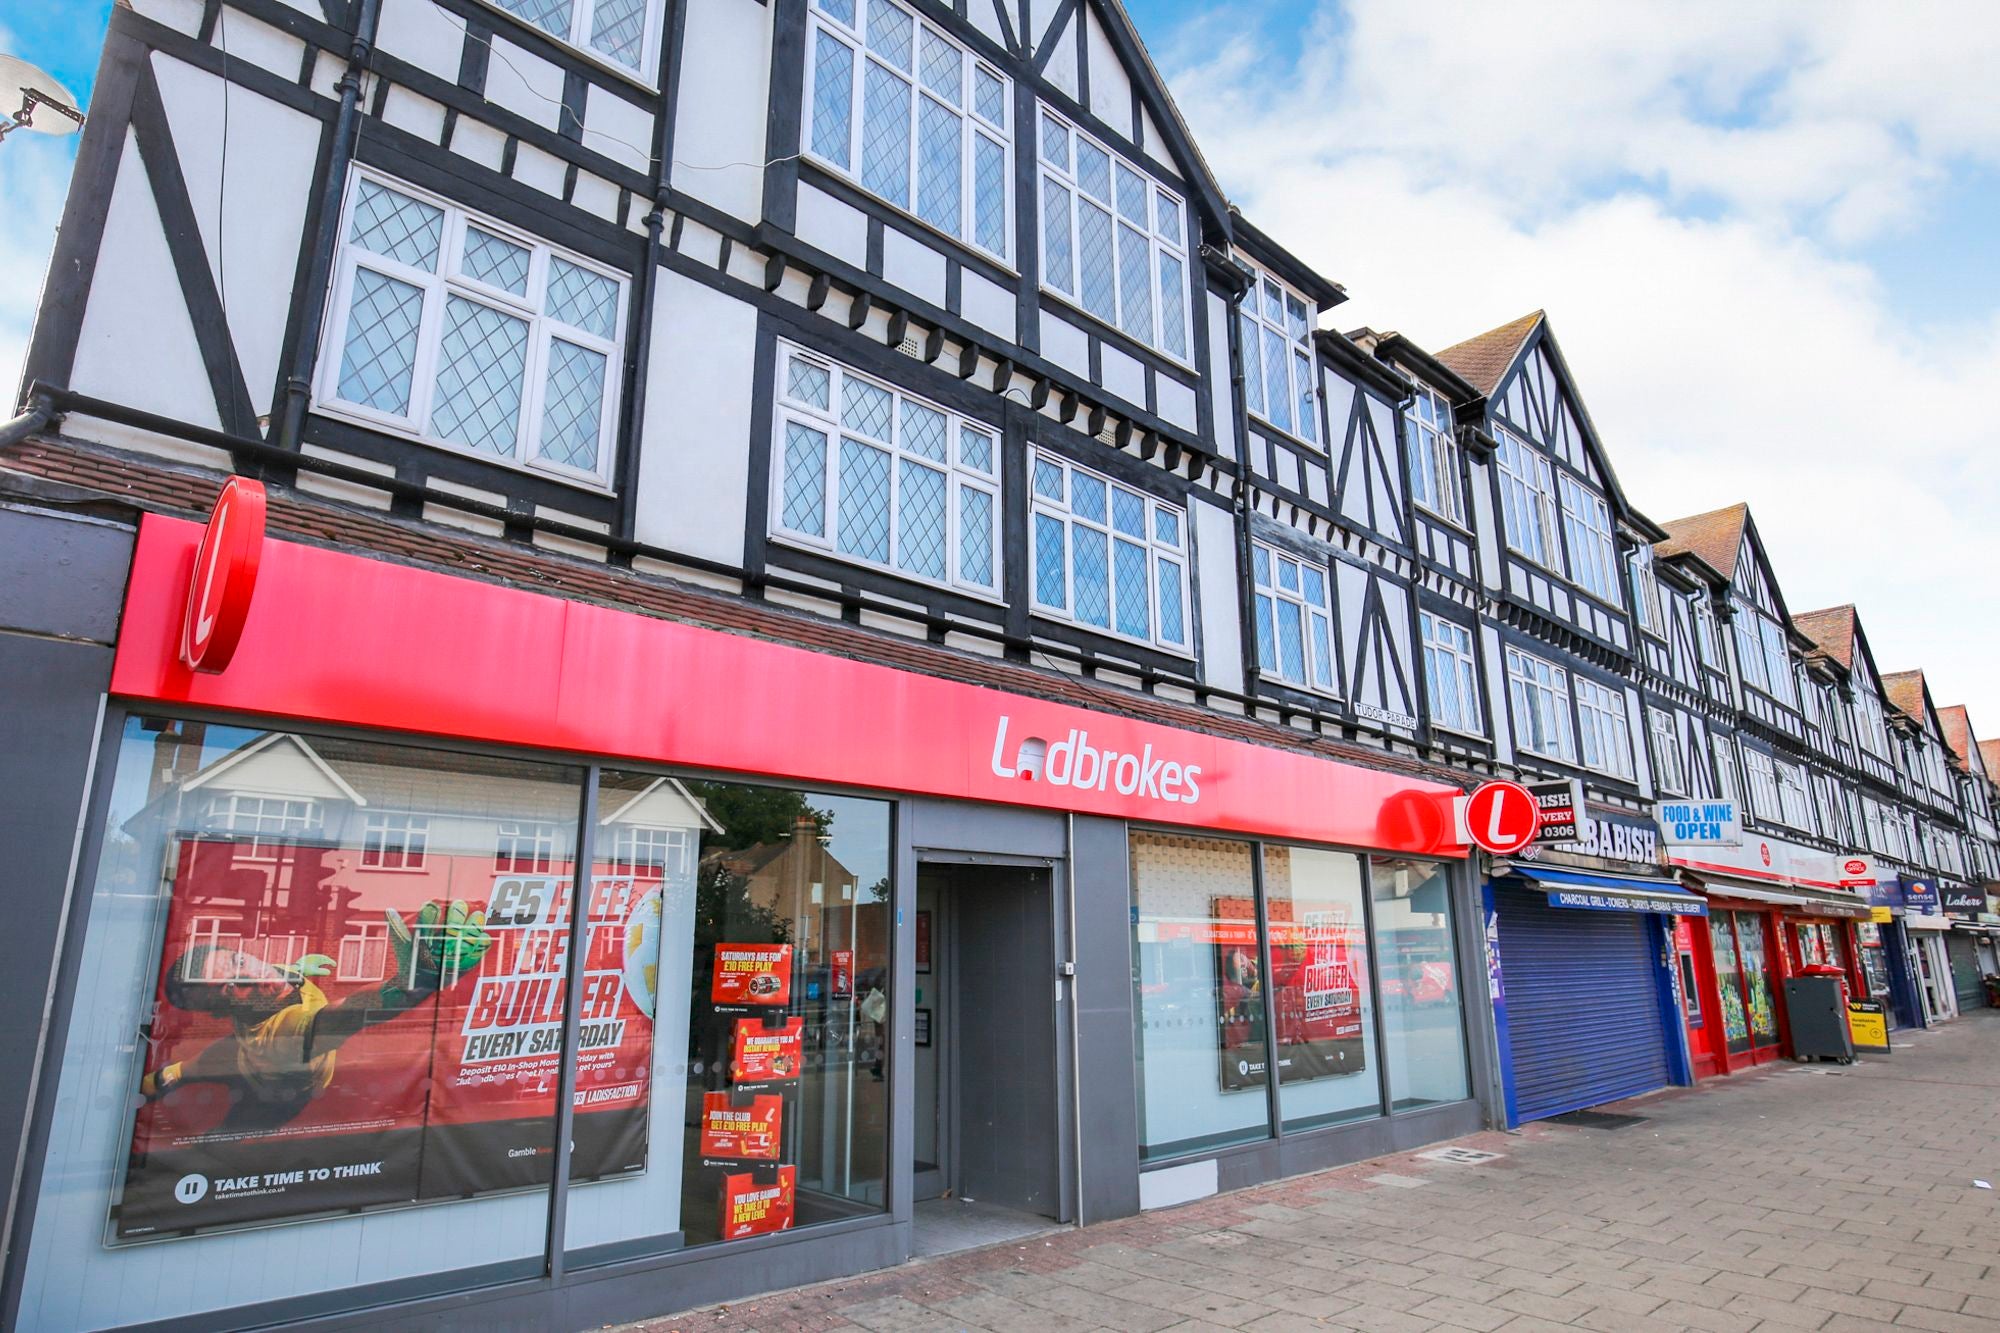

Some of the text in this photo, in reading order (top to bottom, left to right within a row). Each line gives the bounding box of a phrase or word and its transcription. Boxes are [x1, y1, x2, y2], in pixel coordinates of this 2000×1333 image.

[1356, 703, 1417, 730] TUDOR PARADE
[1487, 789, 1517, 845] L
[1663, 804, 1733, 823] FOOD & WINE
[1544, 825, 1575, 838] 0306
[1675, 822, 1721, 840] OPEN
[1554, 818, 1657, 865] BABISH
[486, 879, 631, 927] £5 FEE
[1559, 893, 1590, 906] CHARCOAL
[1590, 895, 1606, 907] GRILL
[1946, 894, 1982, 906] Lakers
[519, 926, 590, 975] BE
[721, 951, 781, 963] SATURDAYS ARE FOR
[724, 961, 773, 972] £10 FREE PLAY
[1305, 964, 1349, 993] BUILDER
[1306, 990, 1351, 1009] EVERY SATURDAY
[465, 1021, 623, 1061] EVERY SATRDAY
[460, 1065, 491, 1077] Deposit
[493, 1063, 506, 1073] £10
[508, 1060, 538, 1071] In-Shop
[539, 1059, 560, 1068] Mond
[599, 1052, 615, 1060] with
[587, 1084, 638, 1104] LADISFACTION
[723, 1111, 735, 1121] THE
[735, 1112, 751, 1122] CLUB
[711, 1121, 769, 1132] GET £10 FREE PLAY
[508, 1147, 537, 1158] Gamble
[214, 1161, 382, 1193] TAKE TIME TO THINK
[215, 1185, 286, 1201] taketimetothink.co.uk
[734, 1193, 747, 1204] YOU
[747, 1191, 760, 1203] LOVE
[734, 1203, 743, 1214] WE
[743, 1201, 757, 1213] TAKE
[733, 1209, 766, 1225] A NEW LEVEL
